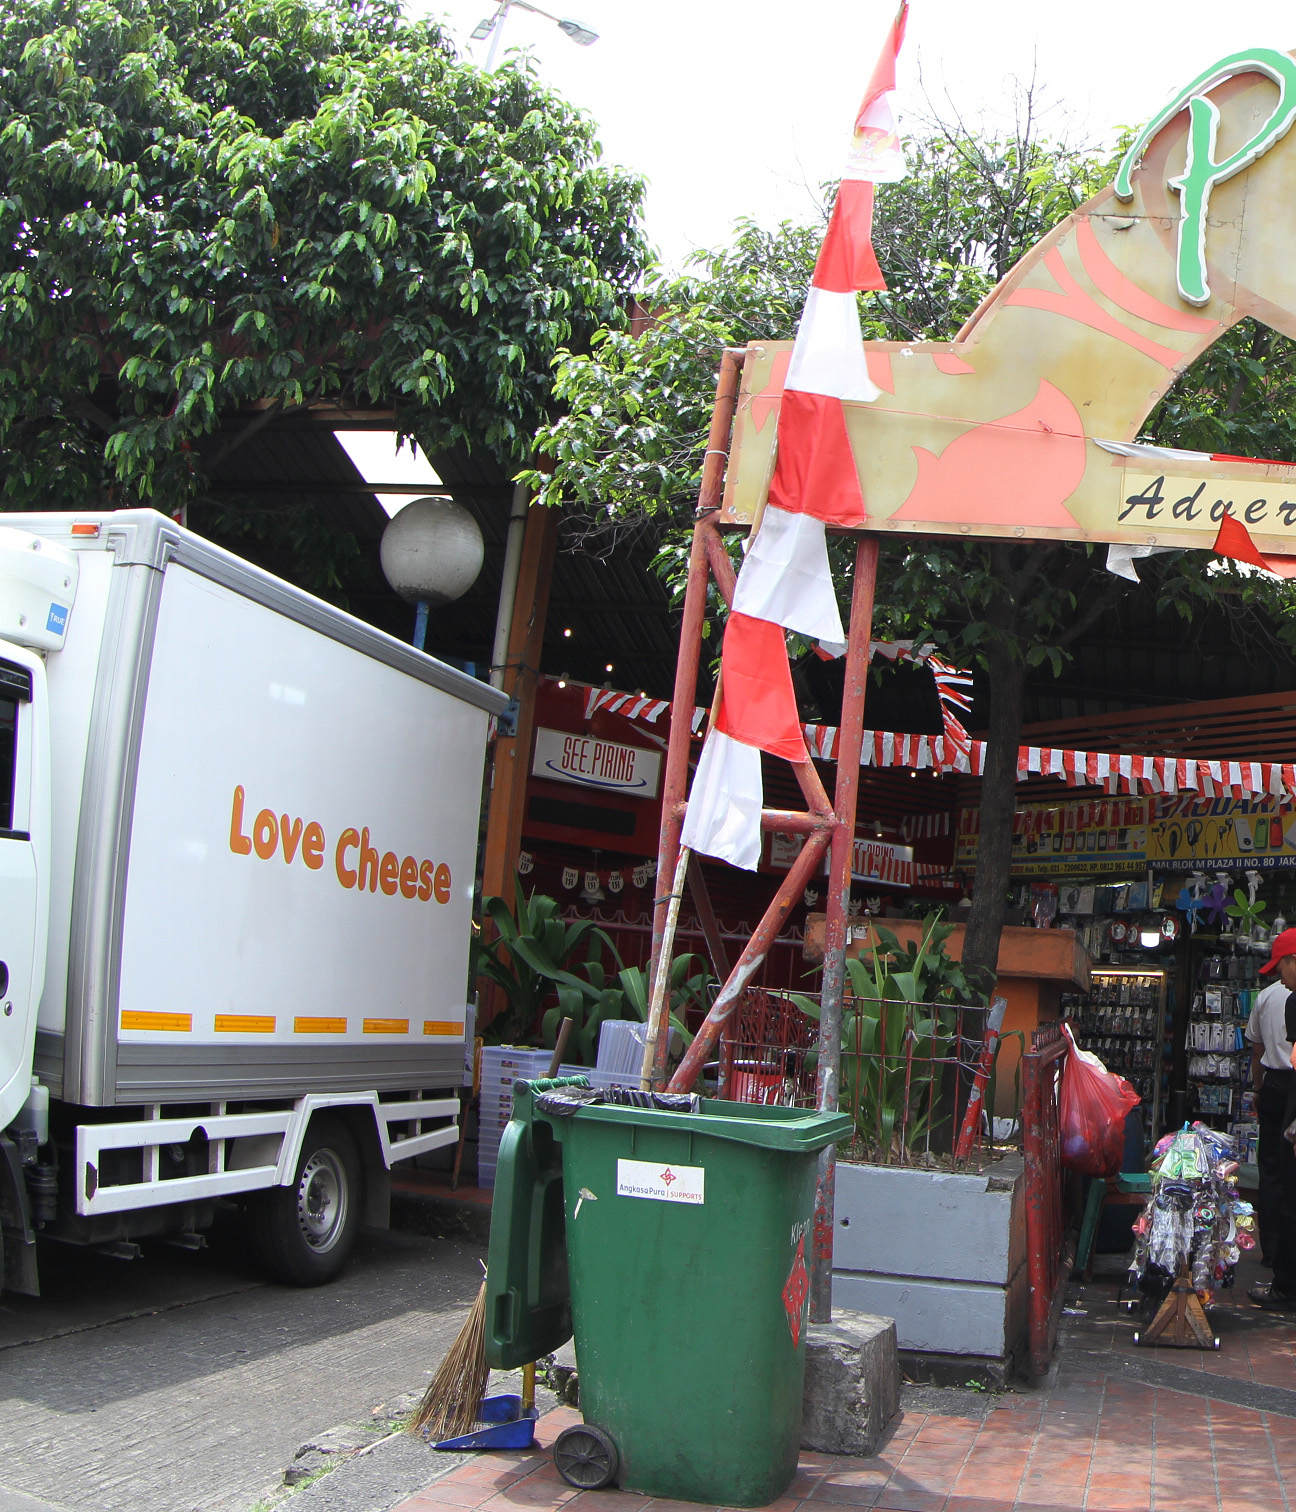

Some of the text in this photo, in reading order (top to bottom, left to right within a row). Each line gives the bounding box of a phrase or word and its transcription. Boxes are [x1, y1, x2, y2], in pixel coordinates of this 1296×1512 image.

[229, 785, 452, 904] Love Cheese
[1207, 858, 1234, 868] PLAZA
[1244, 857, 1261, 867] NO.
[1263, 857, 1275, 867] 80
[670, 1191, 703, 1200] SUPPORTS
